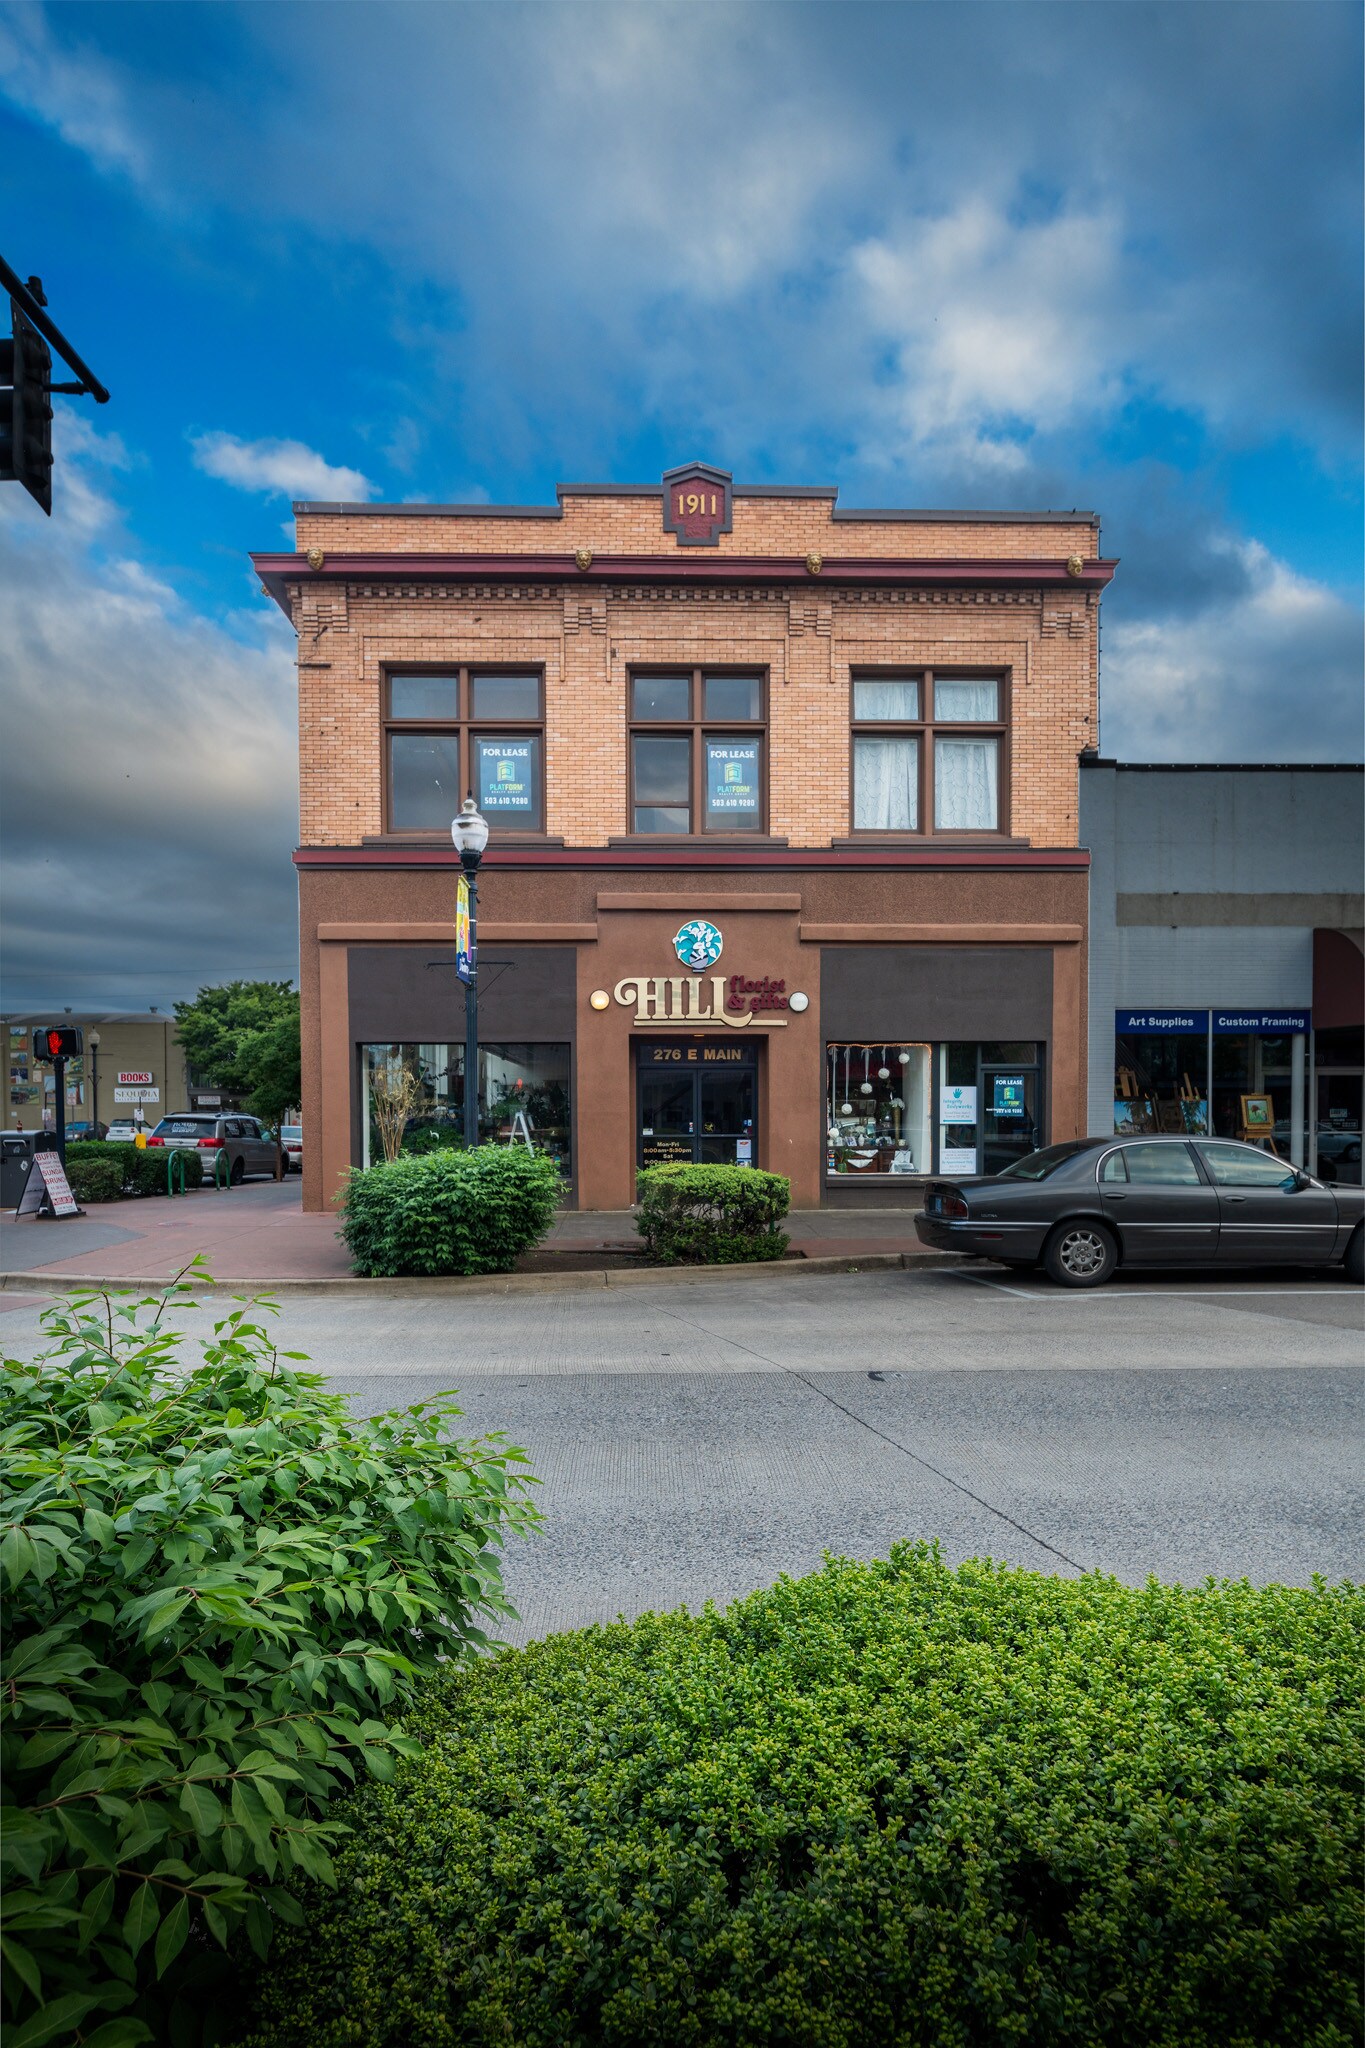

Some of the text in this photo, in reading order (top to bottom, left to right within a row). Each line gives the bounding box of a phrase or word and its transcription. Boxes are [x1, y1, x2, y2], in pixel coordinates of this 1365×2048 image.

[678, 494, 717, 515] 1911
[483, 748, 528, 757] FOR LEASE
[710, 750, 755, 759] FOR LEASE
[489, 783, 523, 791] PLATFORM
[717, 785, 750, 793] PLATFORM
[730, 975, 786, 993] florist
[613, 976, 753, 1028] HILL
[727, 992, 789, 1013] & gifts
[1128, 1017, 1194, 1028] Art Supplies
[1218, 1017, 1304, 1028] Custom Framing
[653, 1048, 742, 1060] 276 E MAIN
[120, 1073, 149, 1082] BOOKS
[45, 1177, 65, 1185] BRUNC
